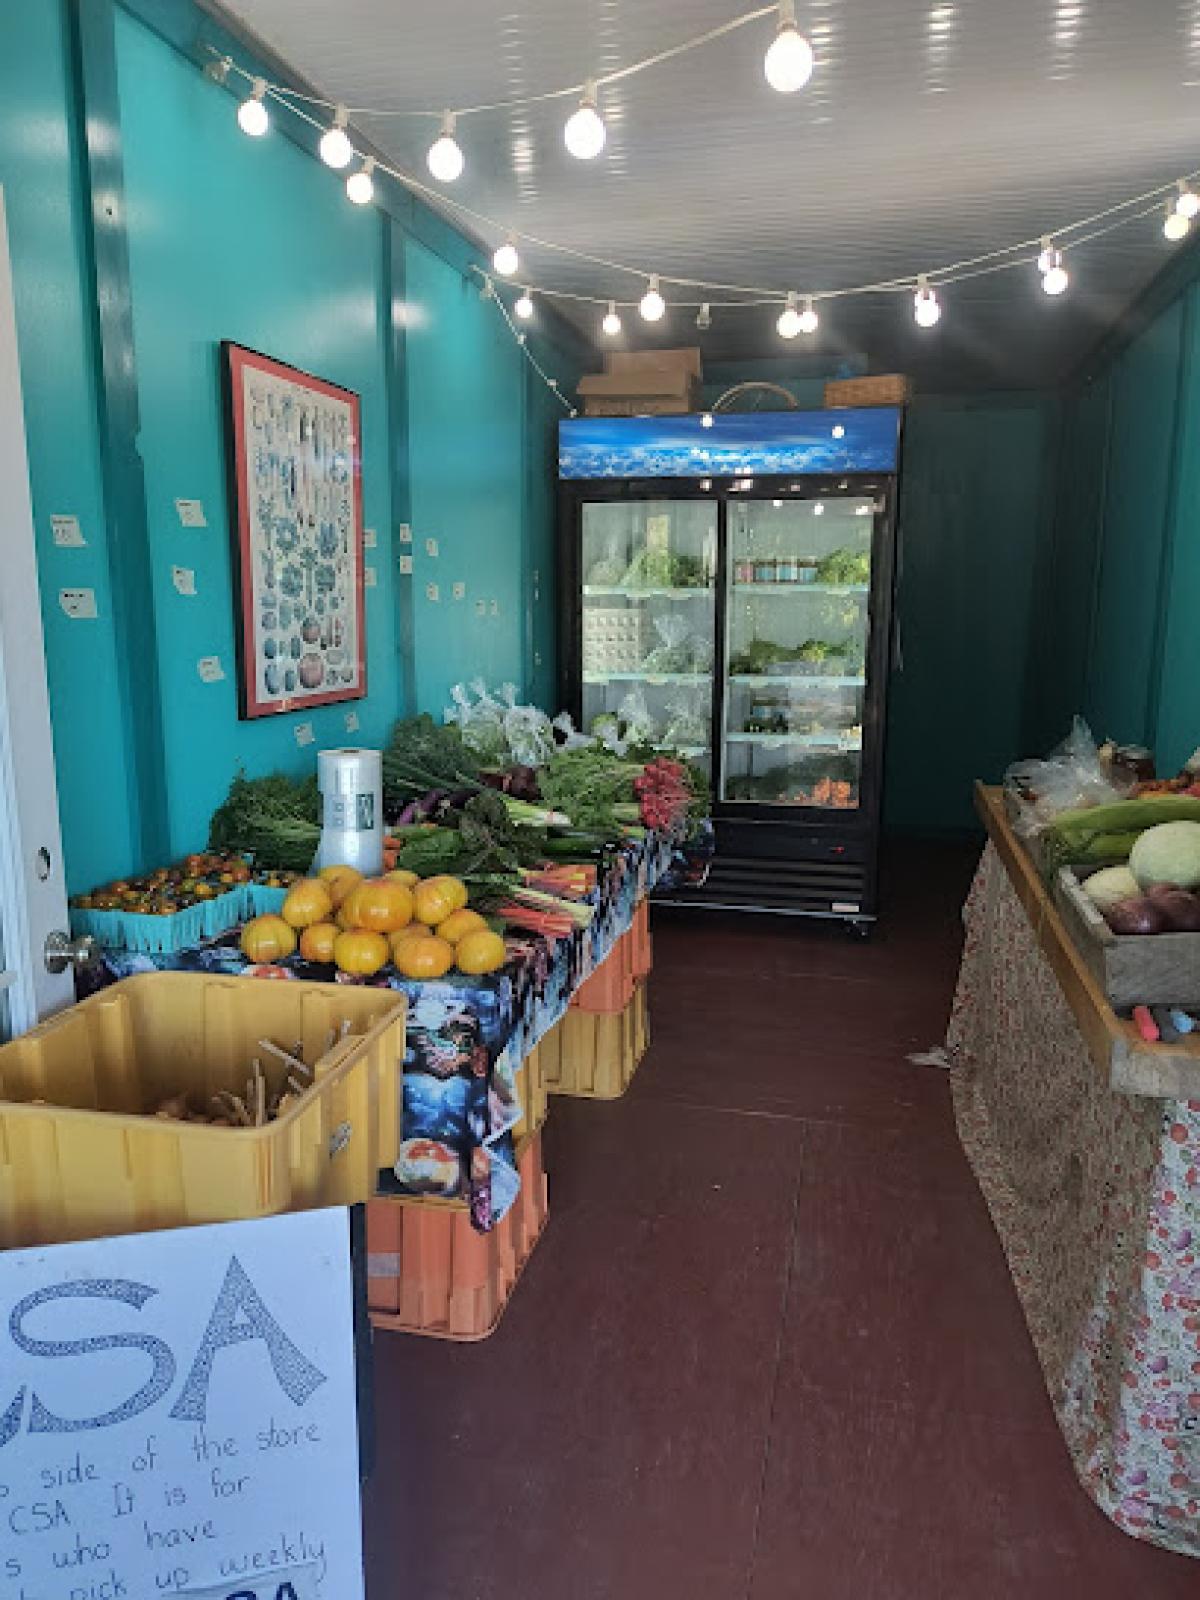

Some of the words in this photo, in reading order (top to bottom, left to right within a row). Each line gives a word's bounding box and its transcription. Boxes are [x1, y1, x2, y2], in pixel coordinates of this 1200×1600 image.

[40, 1452, 100, 1489] side
[132, 1434, 157, 1471] of
[193, 1421, 239, 1462] the
[256, 1417, 321, 1451] store
[8, 1499, 72, 1534] CSA
[164, 1482, 187, 1507] is
[211, 1467, 250, 1498] for
[52, 1531, 111, 1569] who
[144, 1520, 216, 1550] have
[155, 1567, 190, 1591] up
[219, 1531, 327, 1584] weekly
